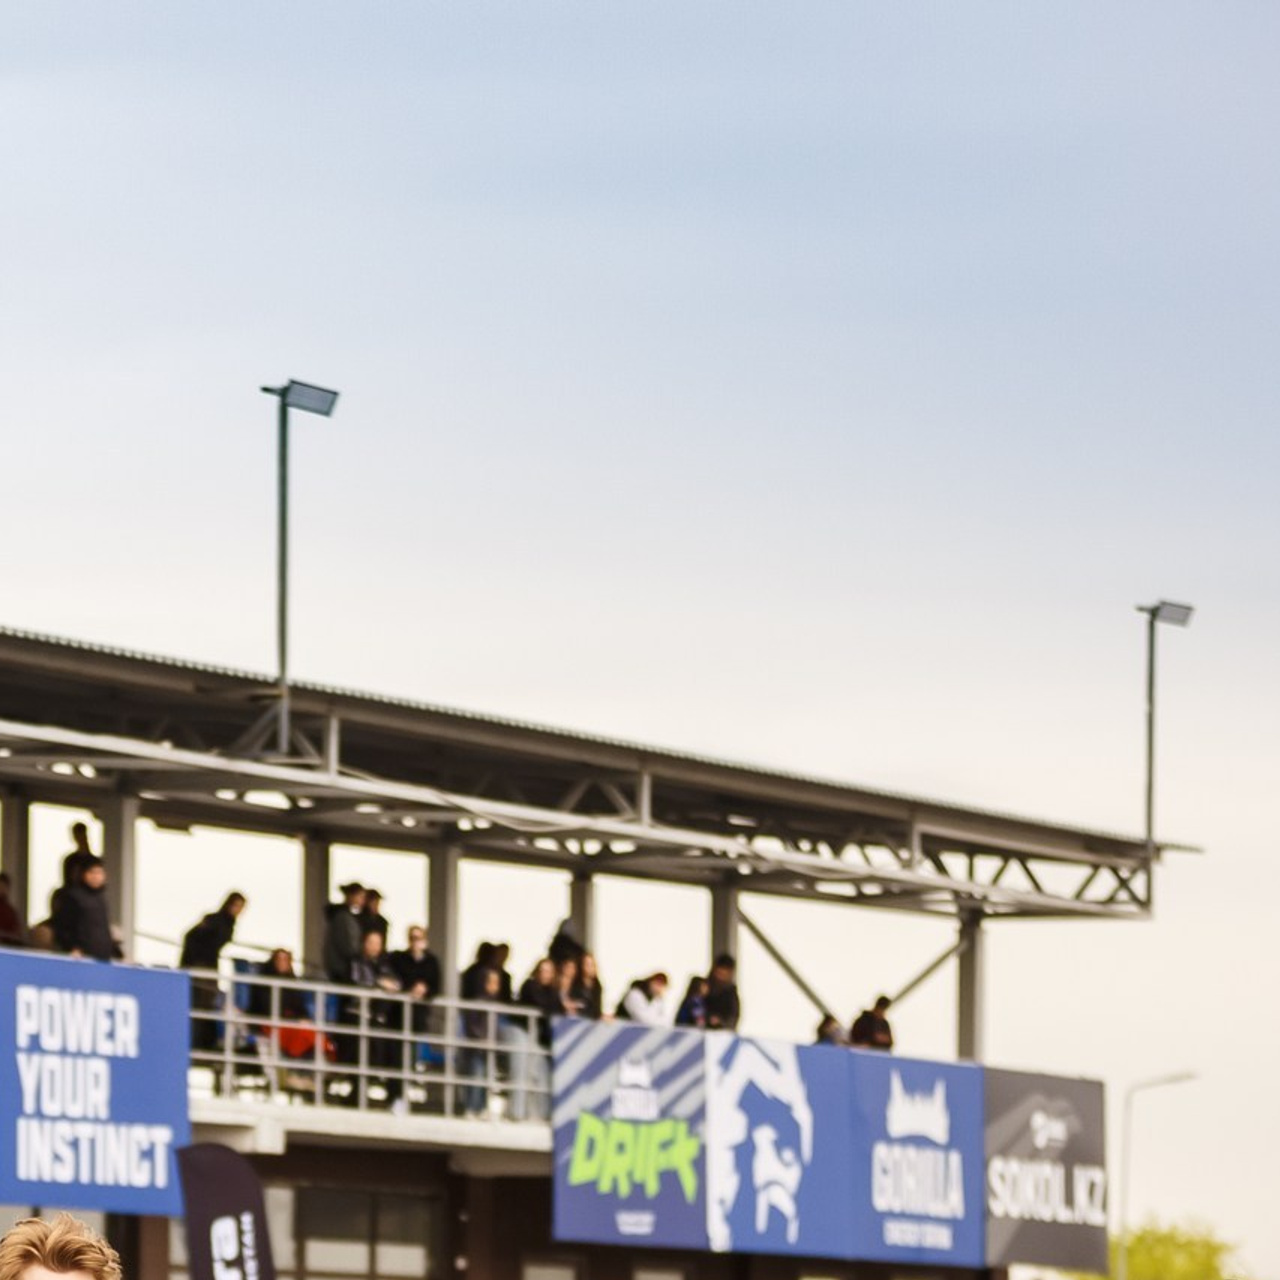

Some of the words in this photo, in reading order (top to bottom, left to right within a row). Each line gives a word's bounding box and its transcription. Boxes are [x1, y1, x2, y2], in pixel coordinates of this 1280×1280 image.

[15, 985, 140, 1059] POWER
[15, 1051, 111, 1120] YOUR
[15, 1117, 173, 1189] INSTINCT
[872, 1141, 966, 1221] GORILLA
